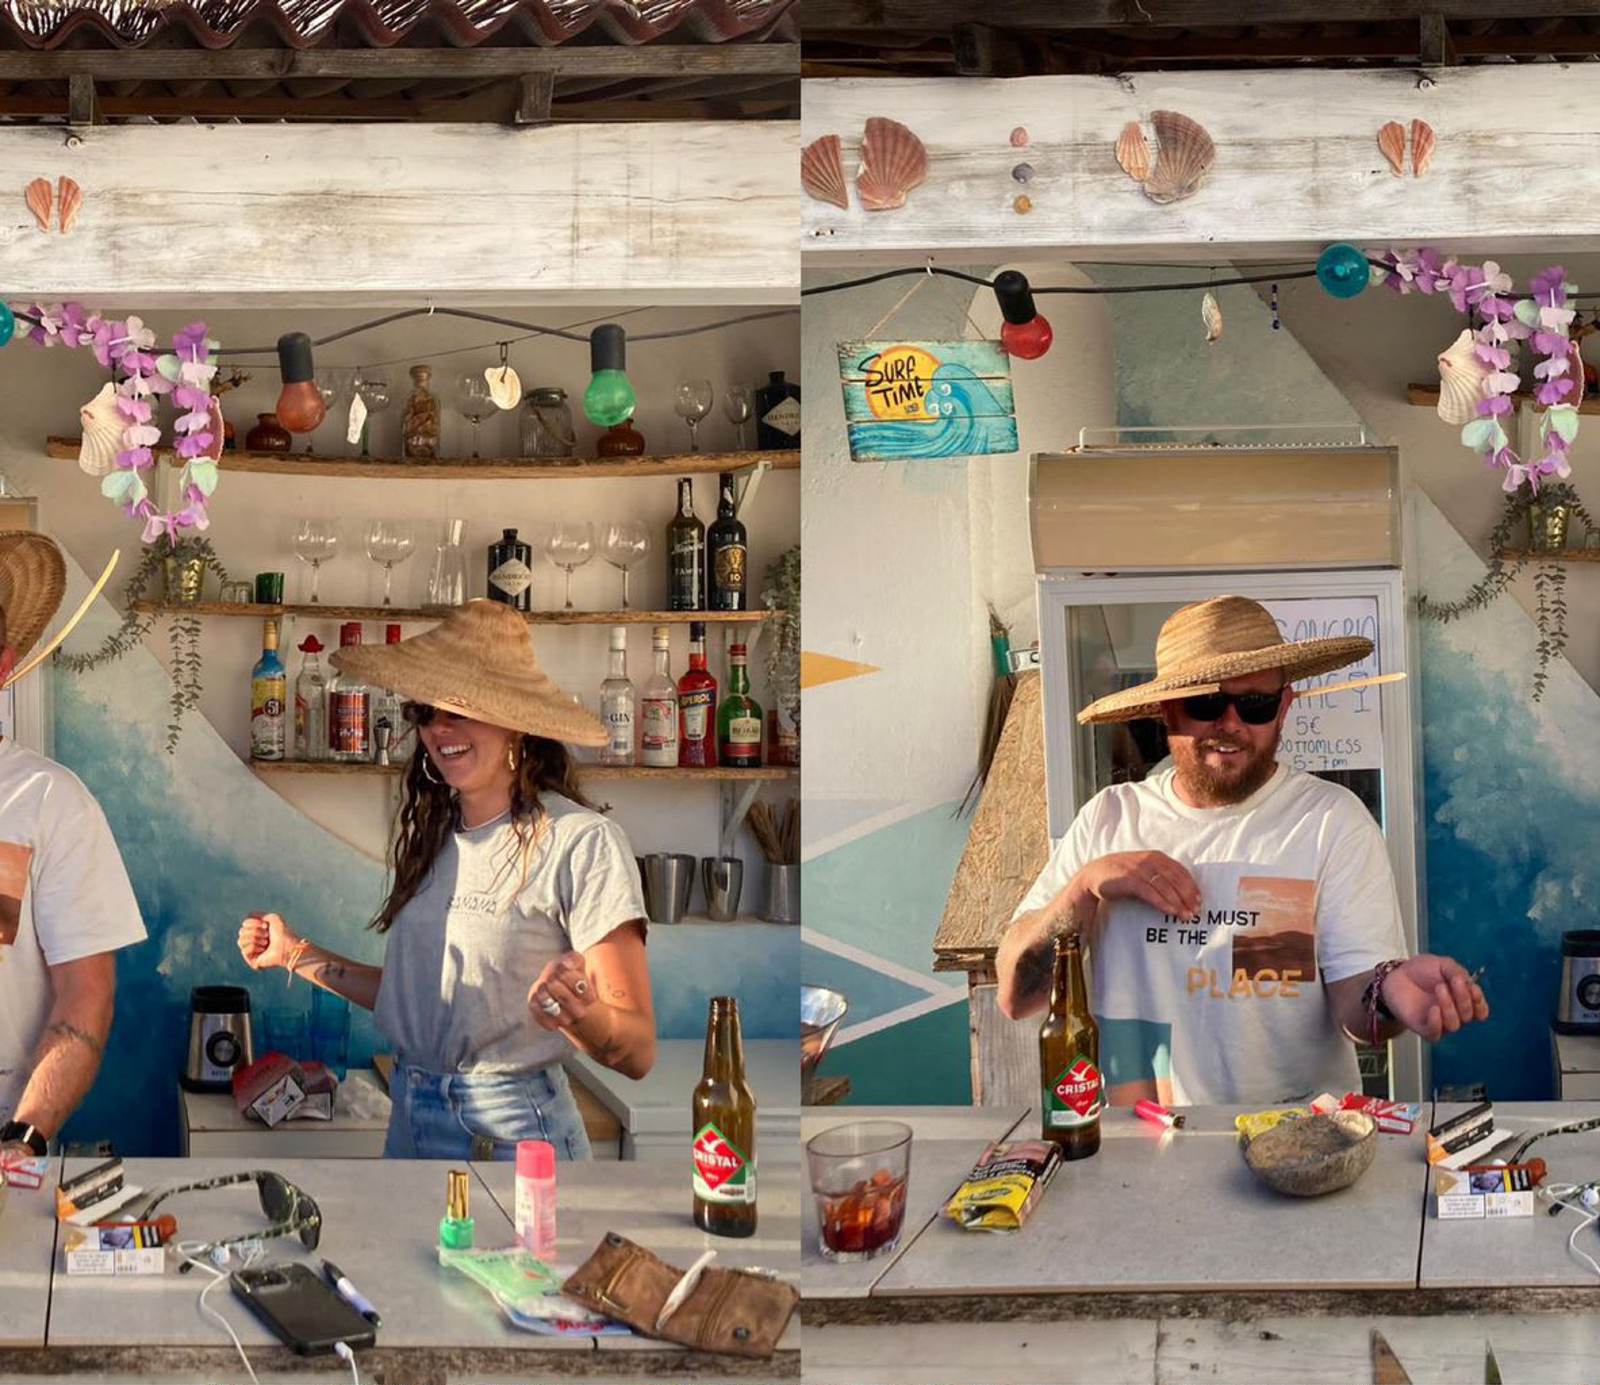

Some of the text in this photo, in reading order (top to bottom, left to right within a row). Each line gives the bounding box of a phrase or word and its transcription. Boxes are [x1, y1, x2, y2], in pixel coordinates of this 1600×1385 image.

[857, 353, 917, 388] SURF
[871, 376, 925, 409] TIME
[266, 699, 280, 717] 51
[610, 711, 631, 723] GIN
[1295, 715, 1321, 736] 5€
[1163, 910, 1260, 927] THS MUST
[1146, 927, 1208, 946] BE THE
[1187, 966, 1303, 999] PLACE
[694, 1149, 737, 1168] RISTAL
